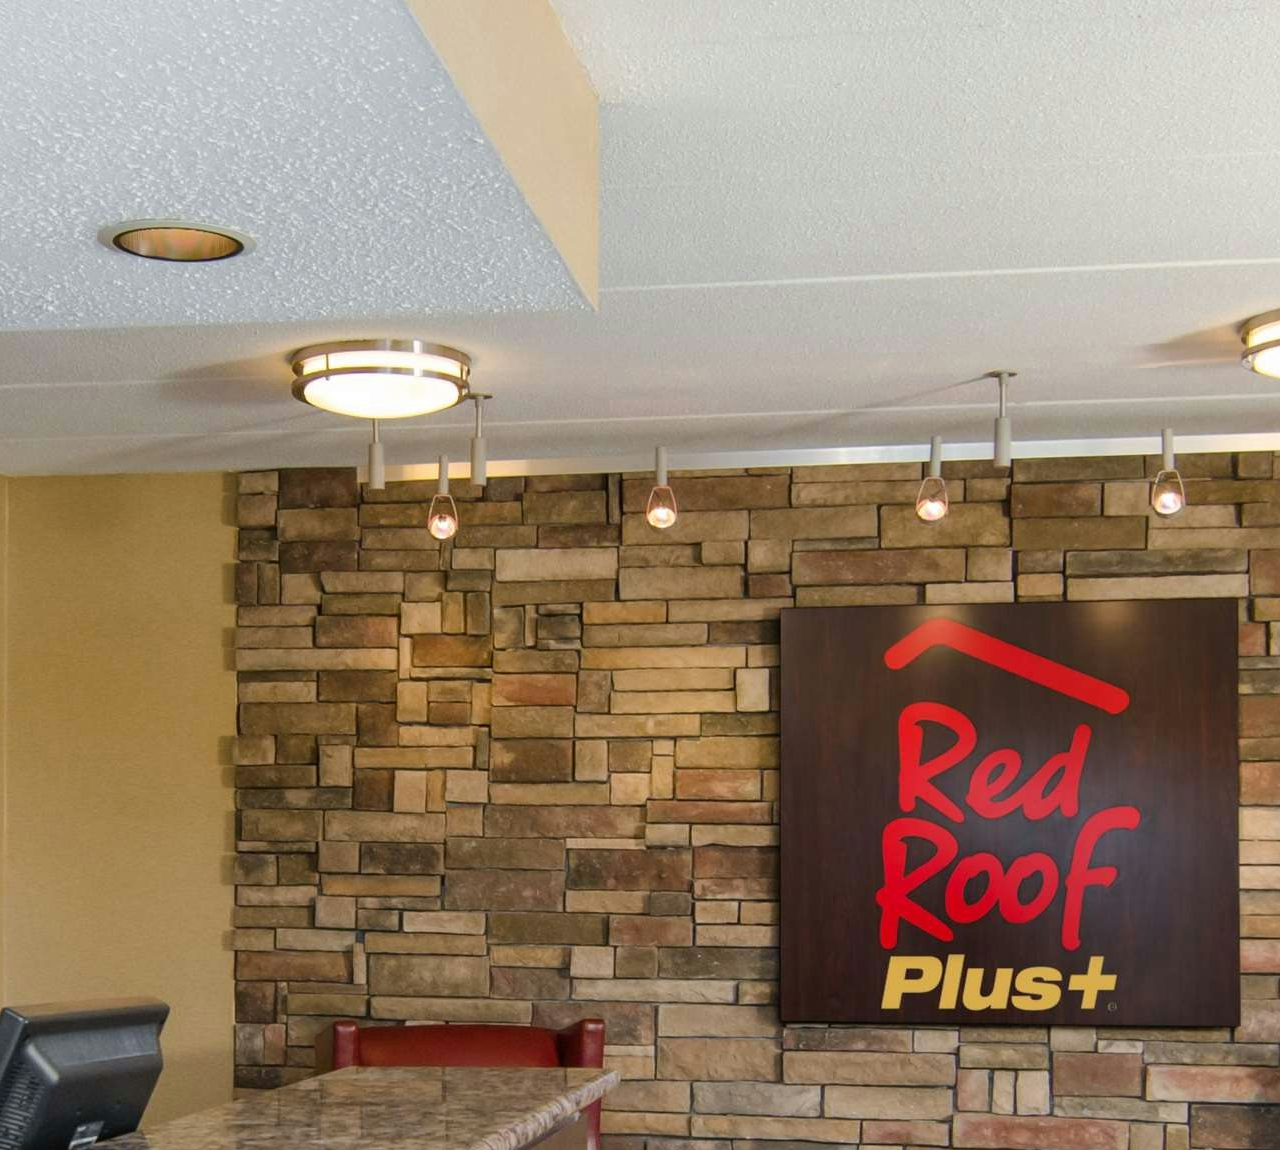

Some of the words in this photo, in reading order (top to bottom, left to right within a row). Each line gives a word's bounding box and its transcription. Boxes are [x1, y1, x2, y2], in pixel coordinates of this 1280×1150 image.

[899, 702, 1092, 823] Red
[876, 806, 1141, 950] Roof
[881, 955, 1117, 1010] Plus+
